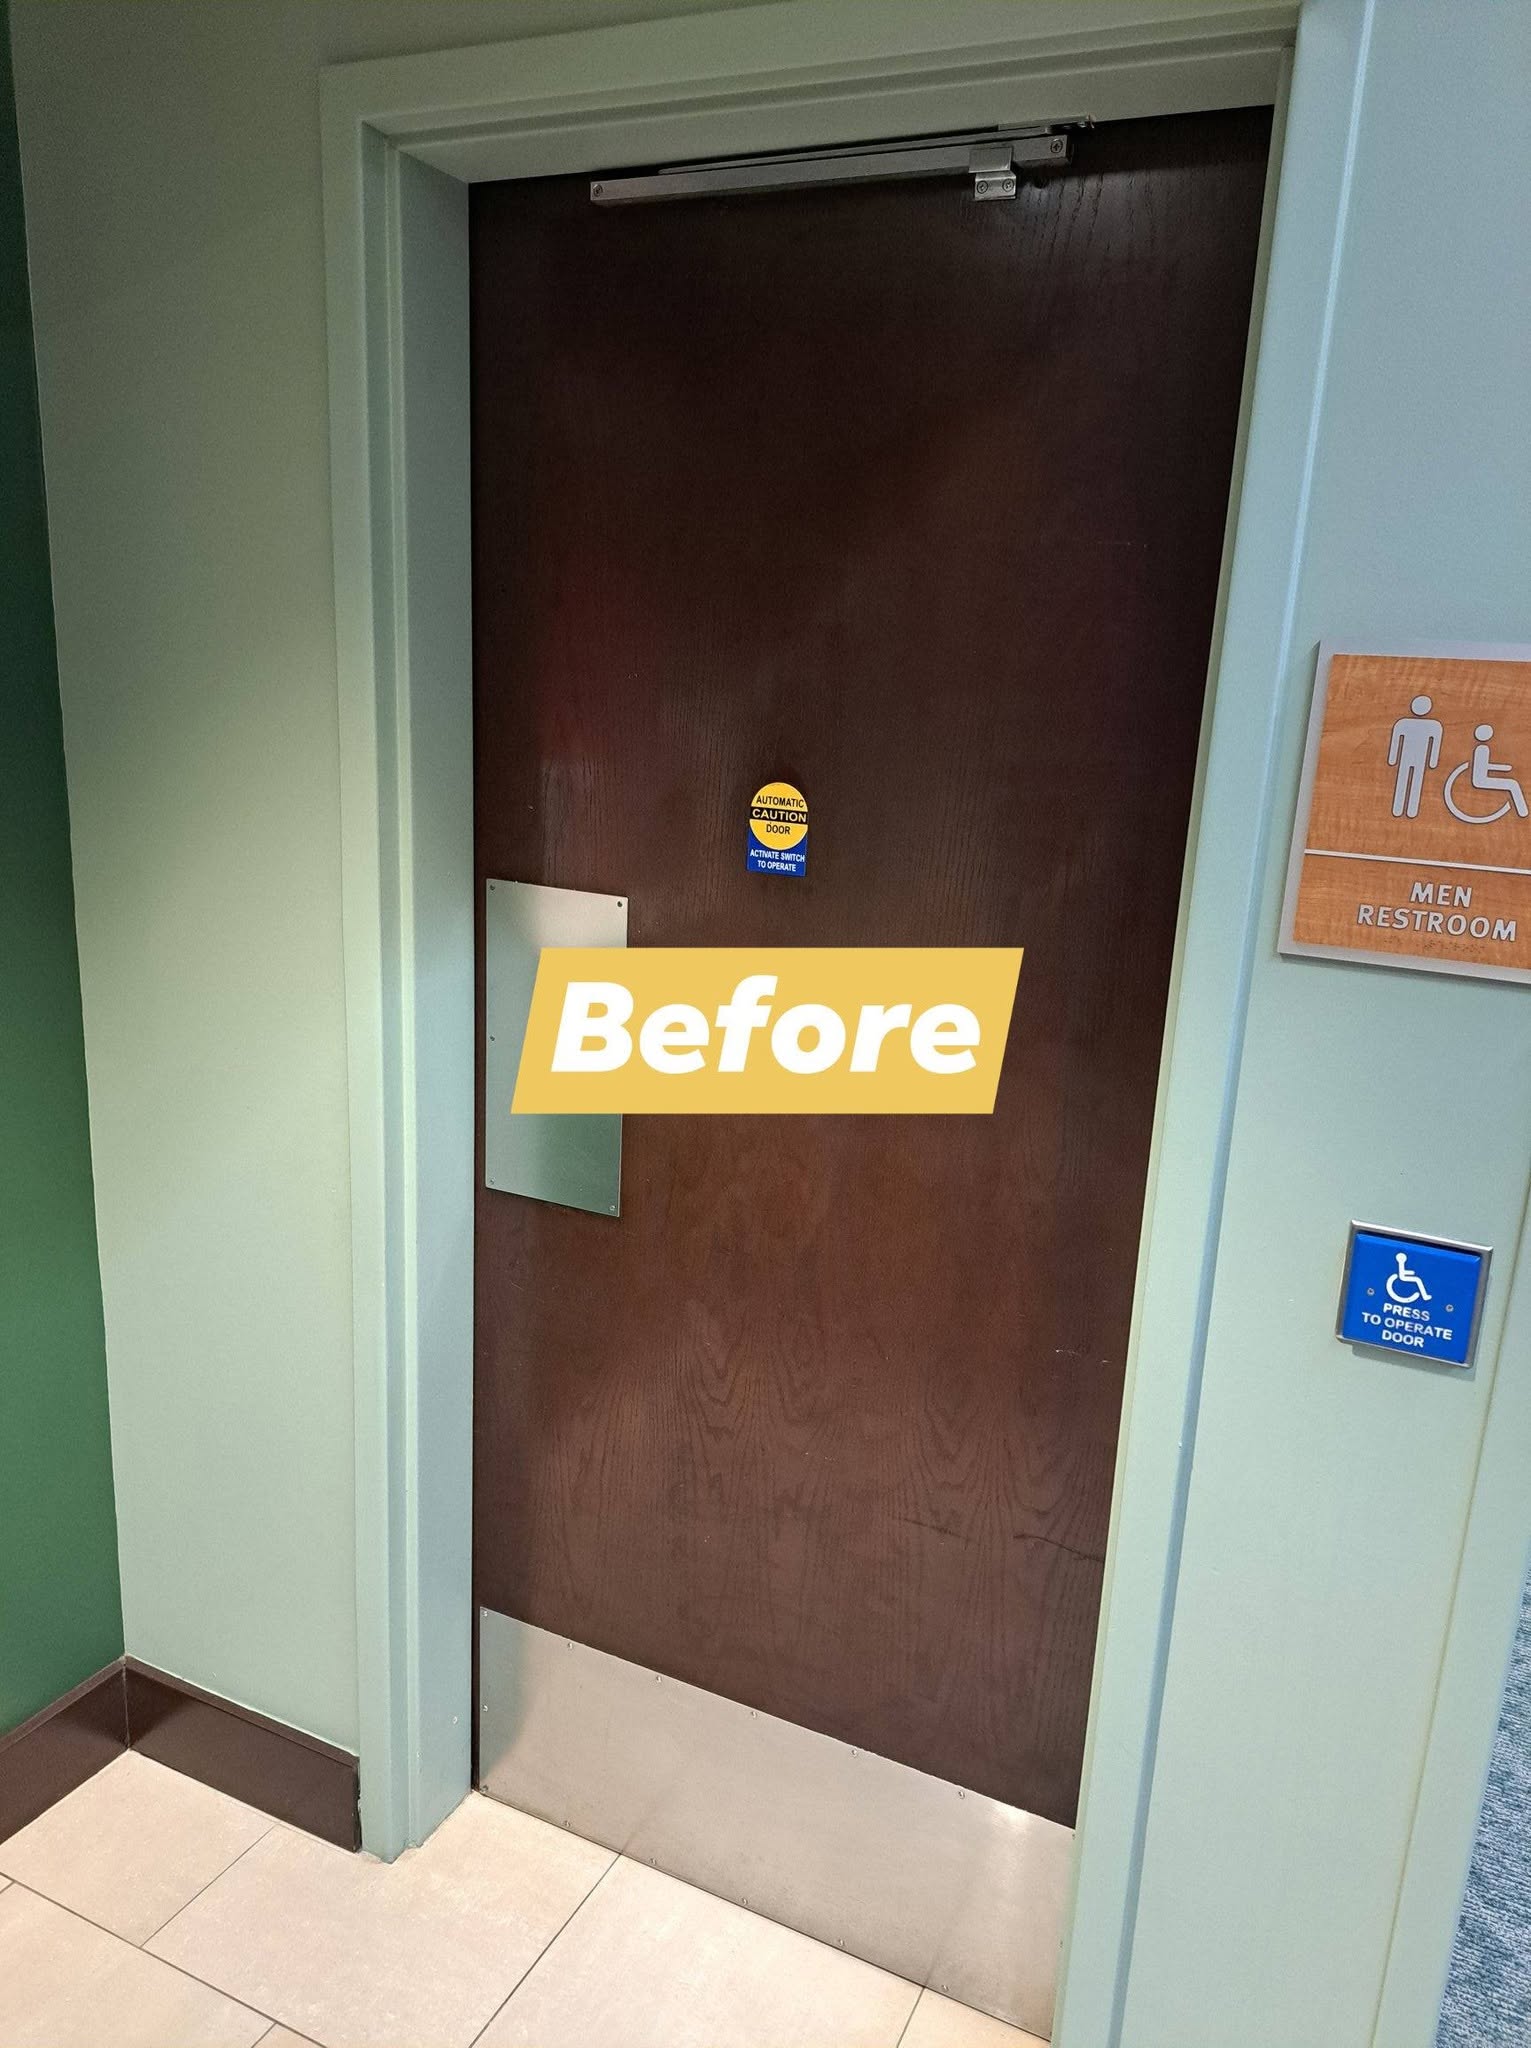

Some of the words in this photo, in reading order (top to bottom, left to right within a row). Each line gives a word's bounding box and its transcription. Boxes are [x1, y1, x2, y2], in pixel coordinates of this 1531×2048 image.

[756, 795, 804, 808] AUTOMATIC
[752, 808, 807, 822] CAUTION
[766, 824, 791, 835] DOOR
[750, 849, 779, 860] ACTIVATE
[781, 852, 805, 862] SWITCH
[757, 860, 765, 868] TO
[767, 861, 796, 872] OPERATE
[1410, 881, 1473, 908] MEN
[1357, 904, 1517, 942] RESTROOM
[1383, 1302, 1430, 1321] PRESS
[1362, 1312, 1381, 1325] TO
[1384, 1318, 1453, 1340] OPERATE
[1382, 1330, 1425, 1348] DOOR
